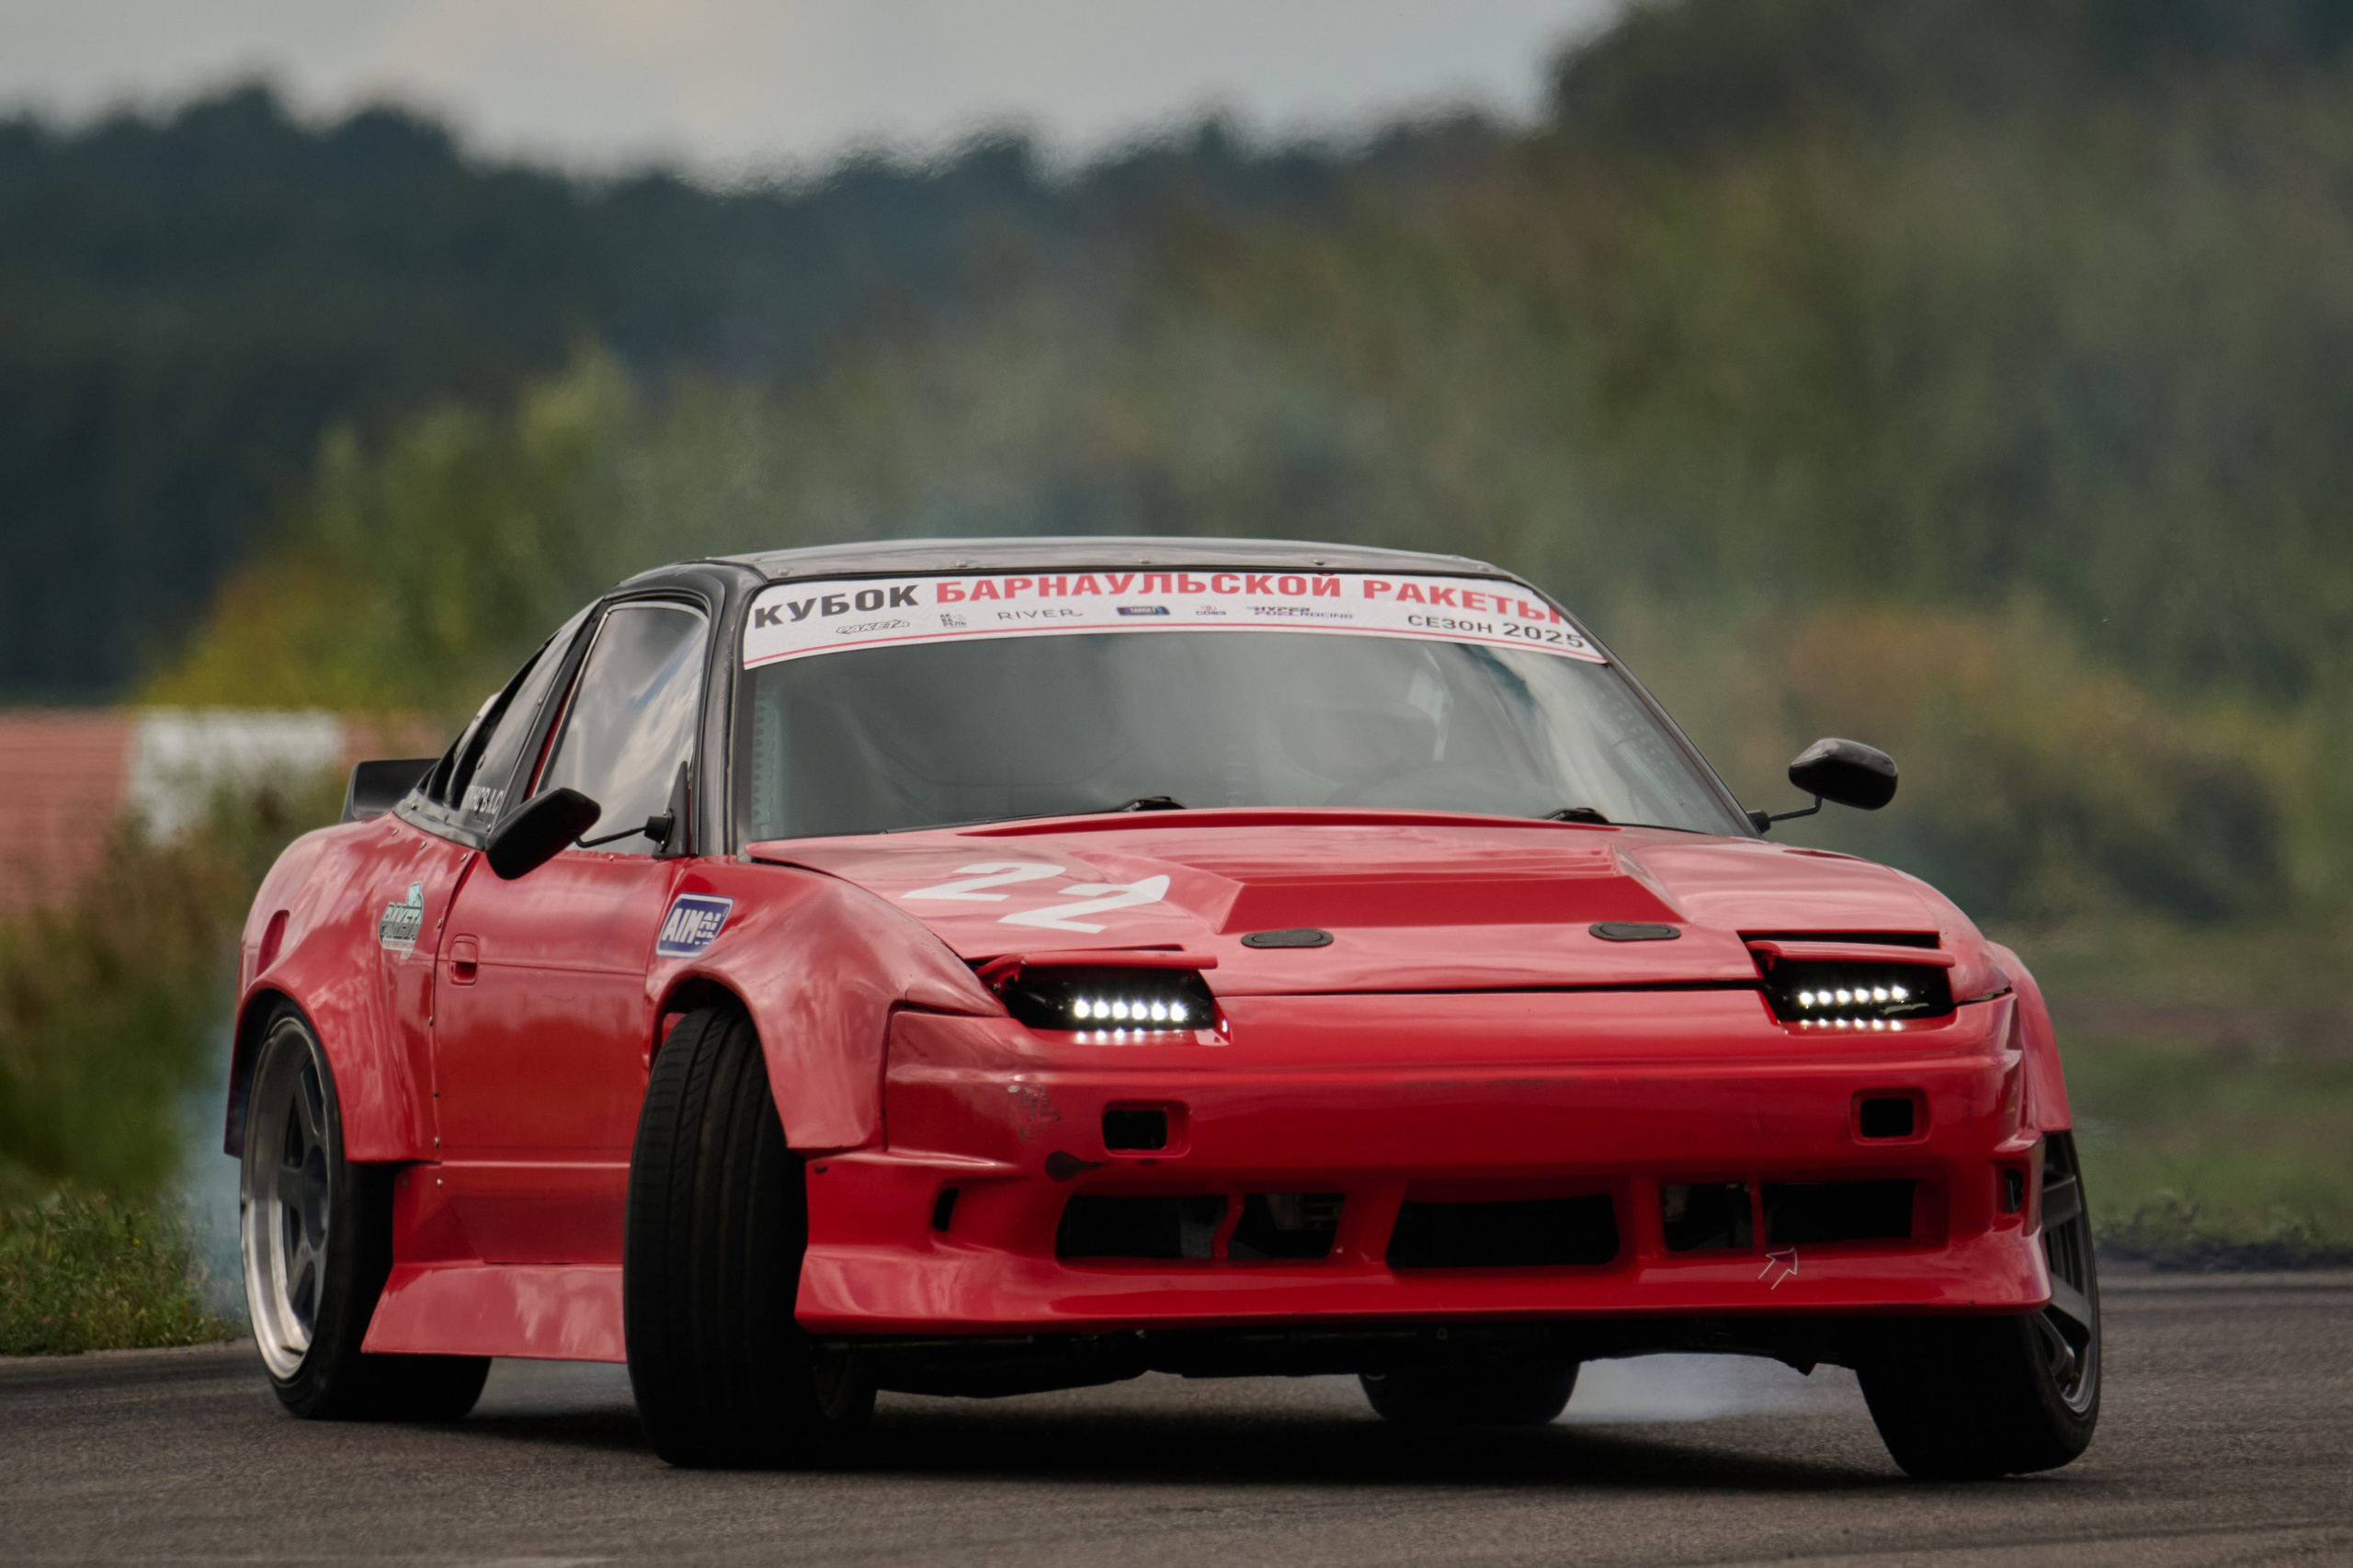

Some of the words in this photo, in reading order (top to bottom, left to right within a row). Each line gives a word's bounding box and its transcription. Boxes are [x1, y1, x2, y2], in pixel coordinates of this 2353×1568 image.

[755, 585, 919, 629] КУБОК
[937, 573, 1341, 603] БАРНАУЛЬСКОЙ
[1363, 579, 1561, 625] РАКЕТЫ
[997, 609, 1083, 619] RIVER
[1408, 615, 1493, 633] СЕЗОН
[1503, 622, 1585, 648] 2025
[901, 862, 1170, 934] 22
